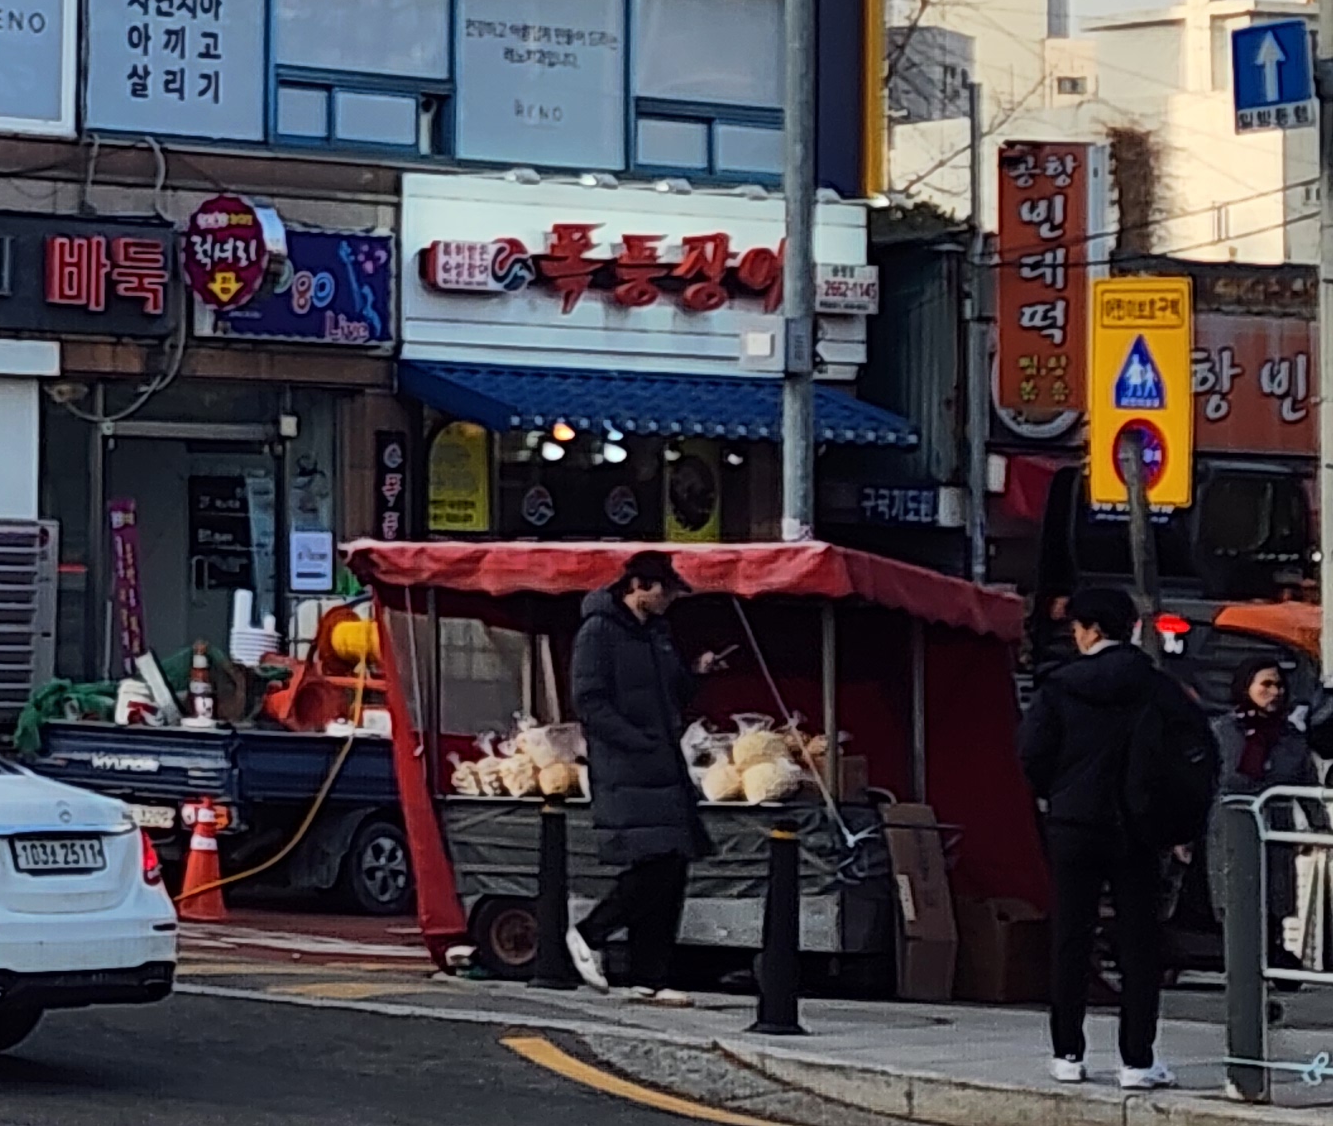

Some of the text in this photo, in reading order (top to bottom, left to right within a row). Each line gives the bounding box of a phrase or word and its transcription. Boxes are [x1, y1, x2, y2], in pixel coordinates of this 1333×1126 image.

[46, 234, 169, 316] 바둑
[1019, 193, 1068, 346] 빈대떡
[63, 841, 100, 866] 2511
